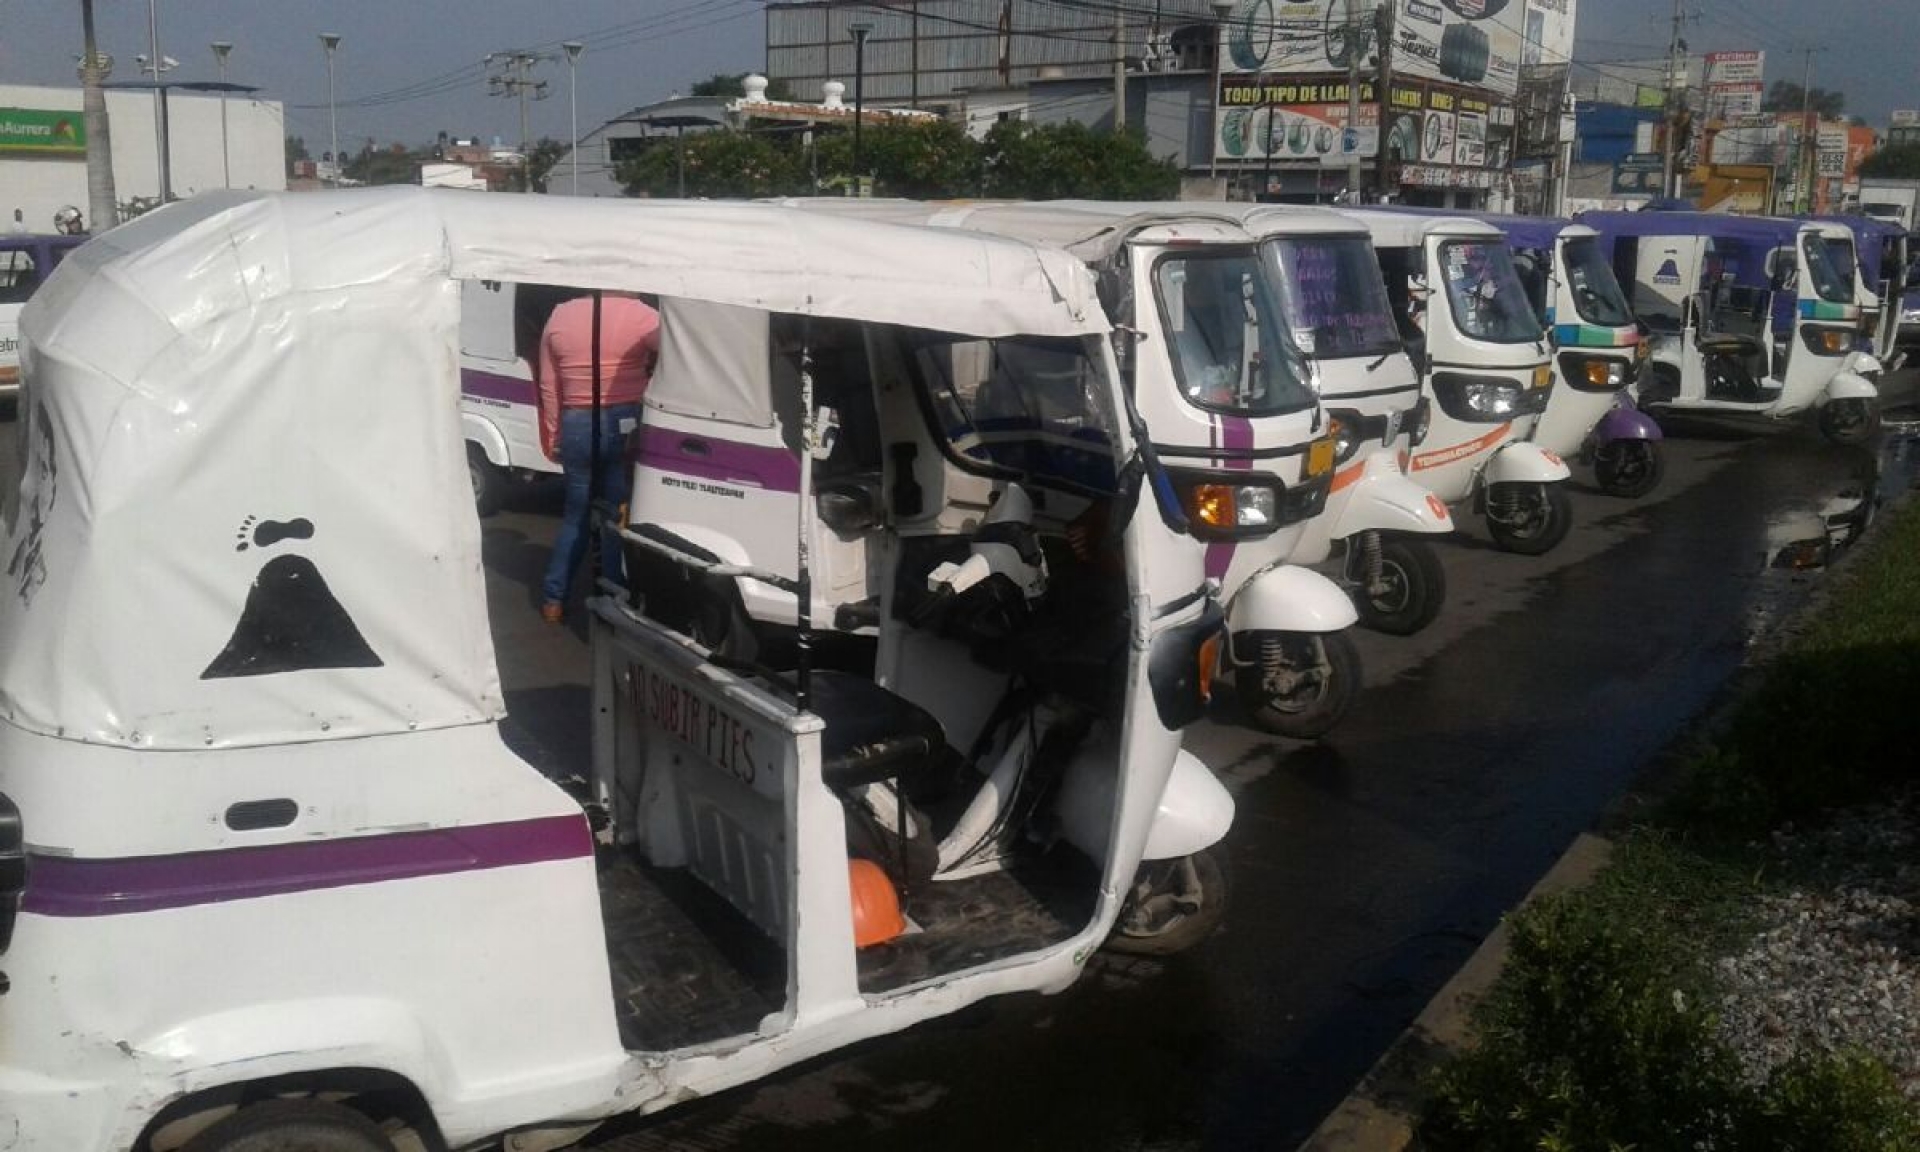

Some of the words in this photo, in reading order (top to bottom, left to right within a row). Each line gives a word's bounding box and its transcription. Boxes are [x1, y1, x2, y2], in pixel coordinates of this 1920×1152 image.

[1224, 87, 1261, 103] TODO
[1264, 86, 1297, 102] TIPO
[1300, 85, 1318, 101] DE
[651, 673, 700, 745] SUBIR
[706, 703, 755, 784] PIES
